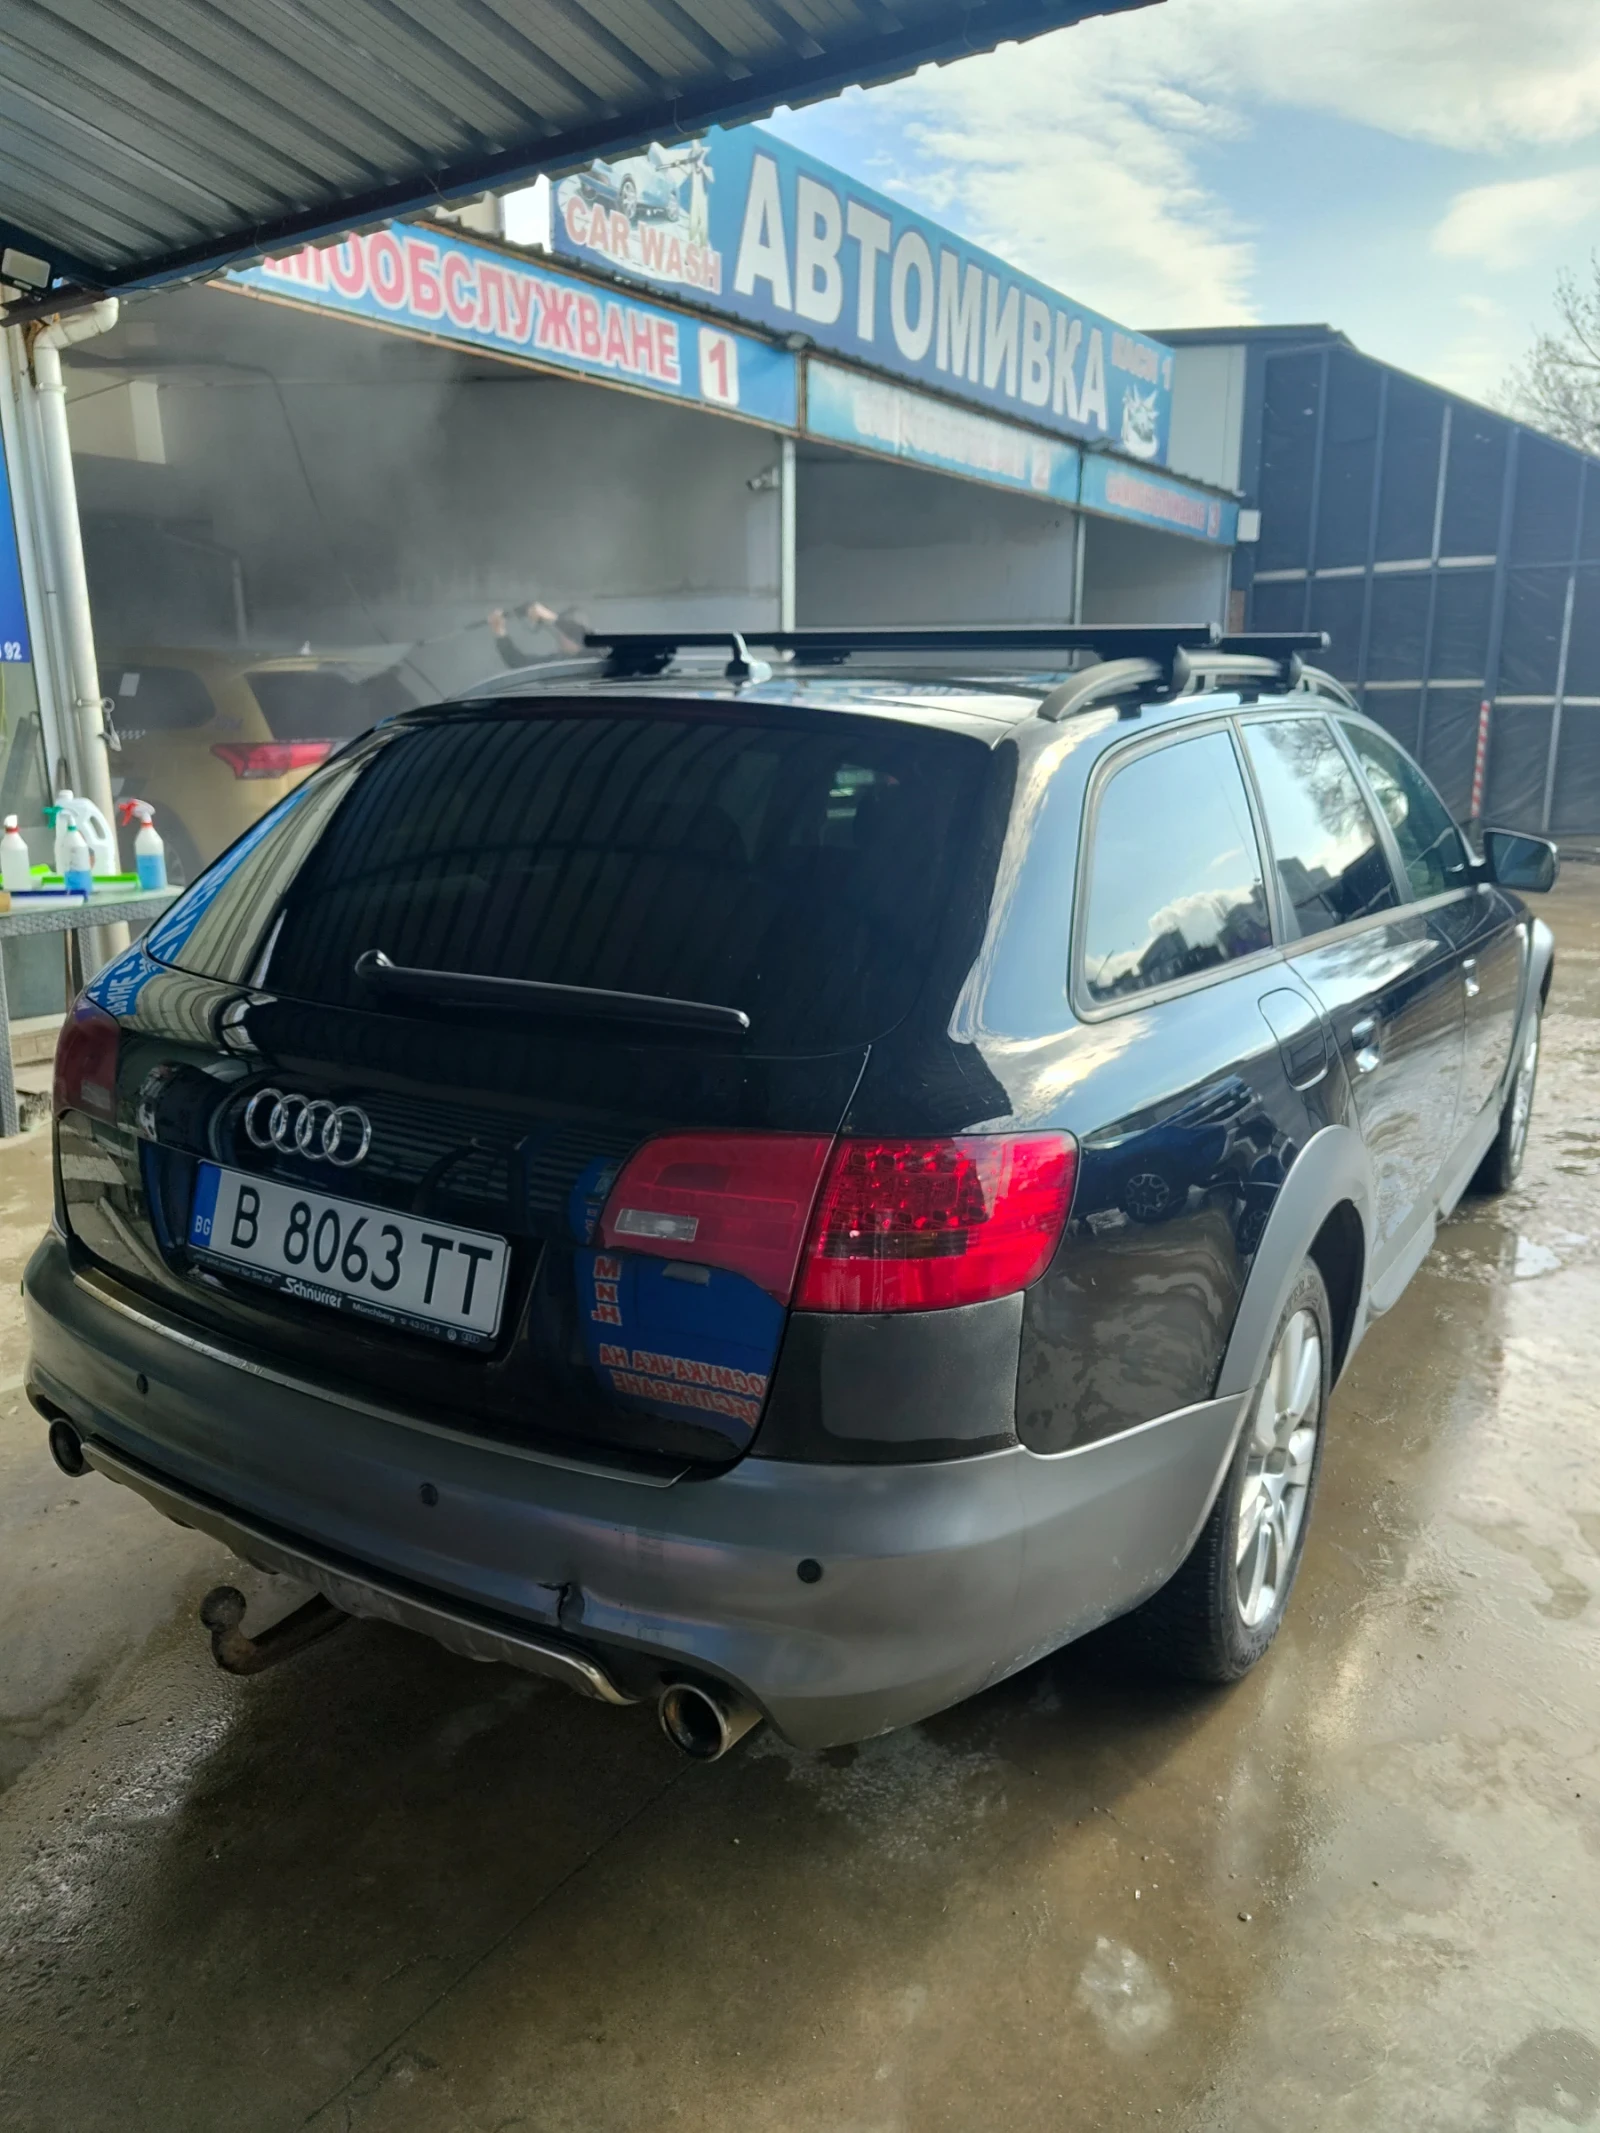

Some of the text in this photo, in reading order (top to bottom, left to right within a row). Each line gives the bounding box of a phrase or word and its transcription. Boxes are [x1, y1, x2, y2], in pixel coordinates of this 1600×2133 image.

[566, 196, 722, 295] CAR WASH
[734, 152, 1109, 432] АВТОМИВКА
[263, 231, 730, 400] ООБСЛУЖВАНЕ 1
[194, 1215, 212, 1237] BG
[230, 1185, 493, 1315] B 8063 TT
[280, 1276, 343, 1309] Schnurrer
